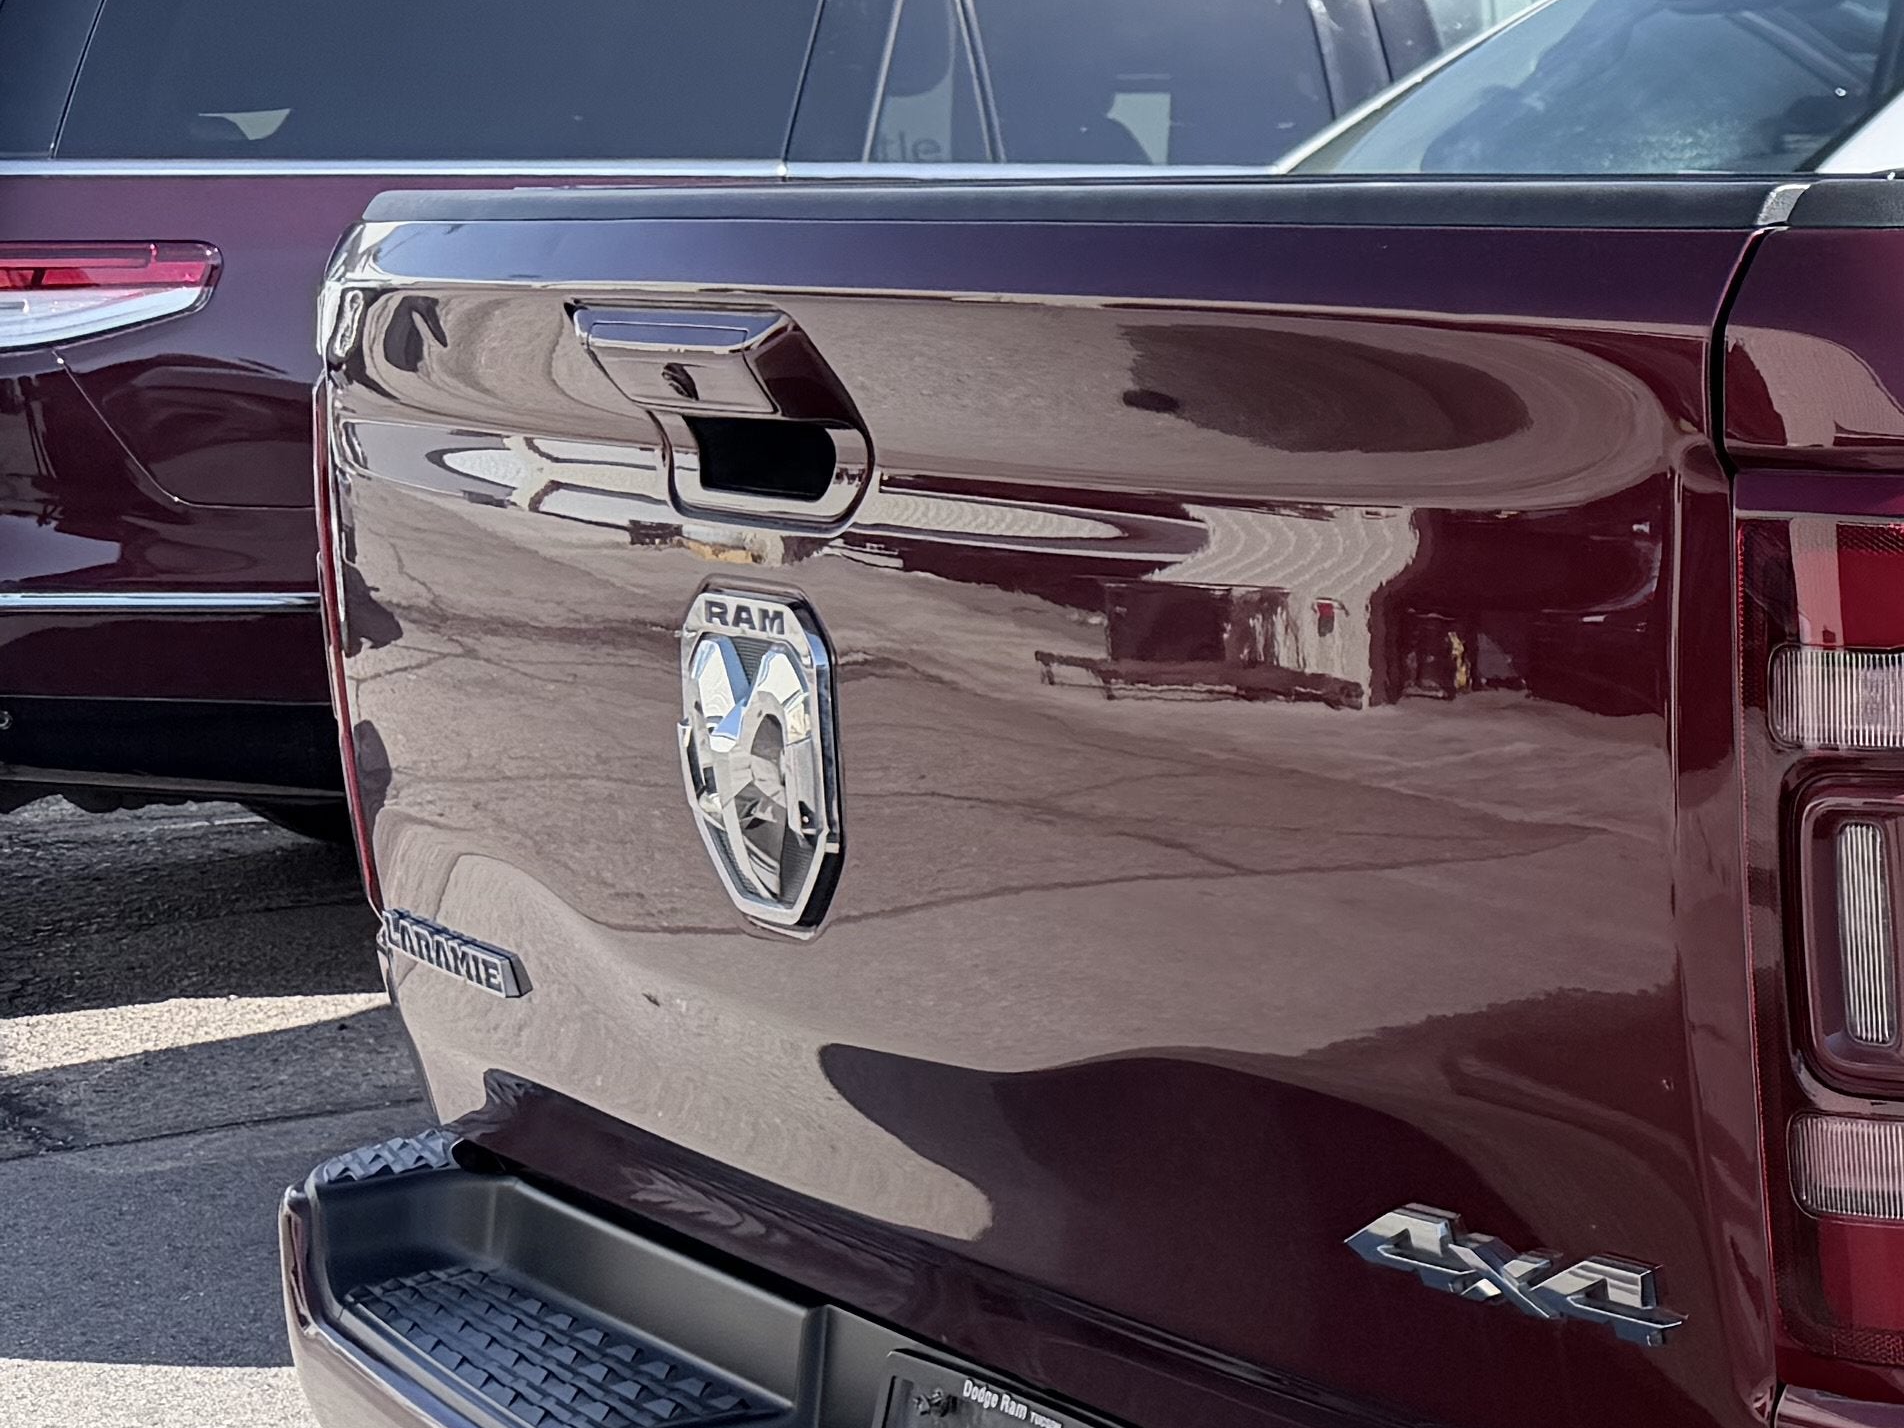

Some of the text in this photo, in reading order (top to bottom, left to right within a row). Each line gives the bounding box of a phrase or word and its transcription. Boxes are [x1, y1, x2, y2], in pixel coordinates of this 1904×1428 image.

[704, 599, 786, 636] RAM
[381, 910, 506, 998] LARAMIE
[962, 1378, 999, 1409] Dodge
[1000, 1393, 1028, 1420] Ram
